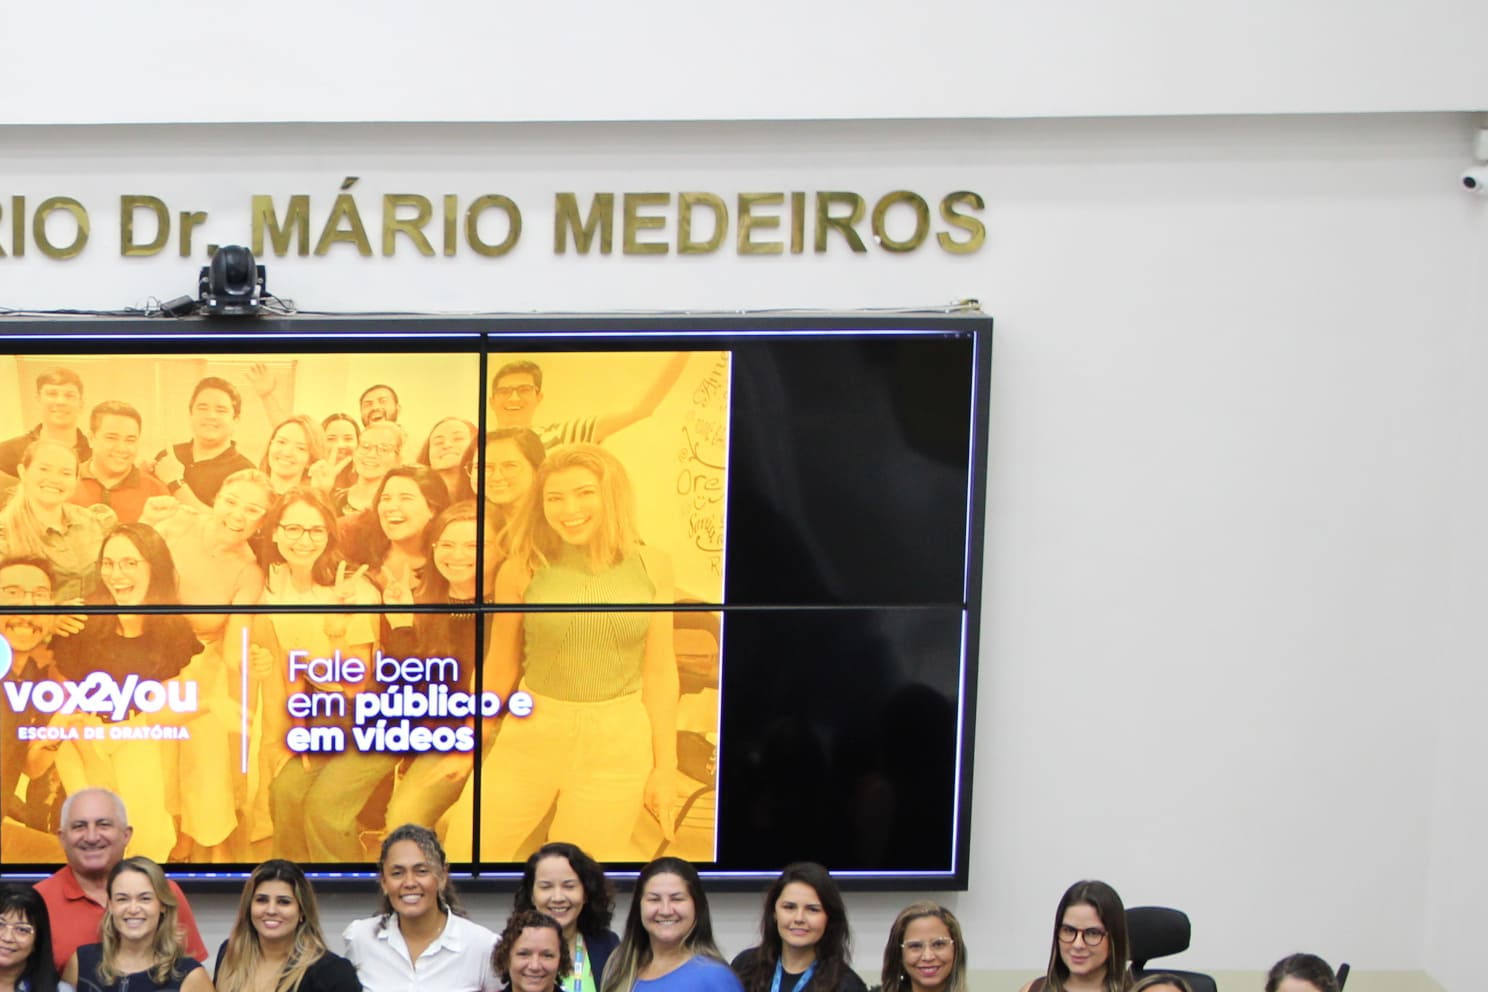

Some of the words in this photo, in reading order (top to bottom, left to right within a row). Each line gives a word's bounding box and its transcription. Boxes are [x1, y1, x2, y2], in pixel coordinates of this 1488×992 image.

[251, 176, 523, 257] MÁRIO
[553, 190, 988, 256] MEDEIROS
[288, 649, 365, 682] Fale
[375, 649, 459, 682] bem
[3, 671, 198, 721] vox2you
[287, 692, 345, 717] em
[355, 684, 501, 725] público
[508, 691, 533, 717] e
[17, 726, 79, 740] ESCOLA
[83, 726, 105, 740] DE
[109, 724, 190, 740] ORATÓRIA
[286, 726, 344, 752] em
[352, 719, 475, 752] vídeos
